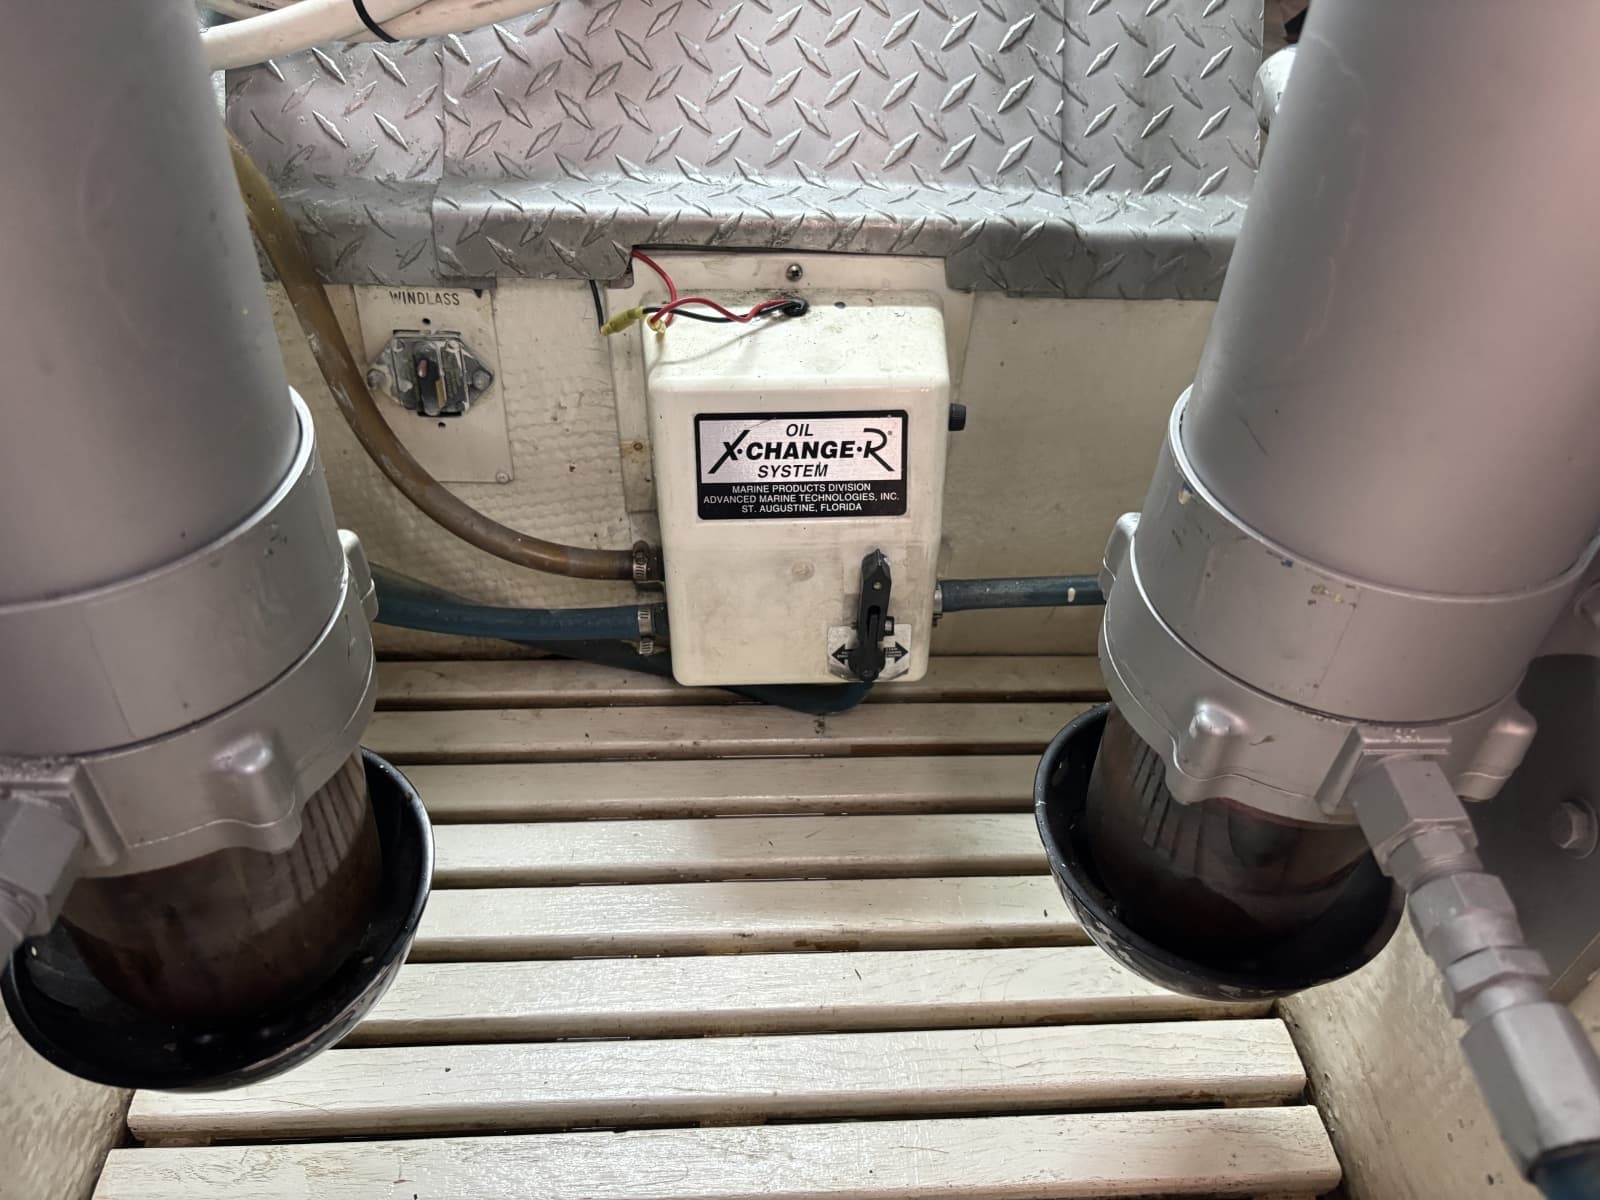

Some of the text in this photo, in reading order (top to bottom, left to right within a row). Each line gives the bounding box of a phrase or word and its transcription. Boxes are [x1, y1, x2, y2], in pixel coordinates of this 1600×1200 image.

[389, 291, 460, 306] WINDLASS
[786, 423, 814, 437] OIL
[757, 463, 829, 478] SYSTEM
[732, 483, 871, 494] MARINE PRODUCTS DIVISION
[703, 492, 900, 504] ADVANCED MARINE TECHNOLOGIES, INC.
[741, 502, 862, 513] ST. AUGUSTINE, FLORIDA
